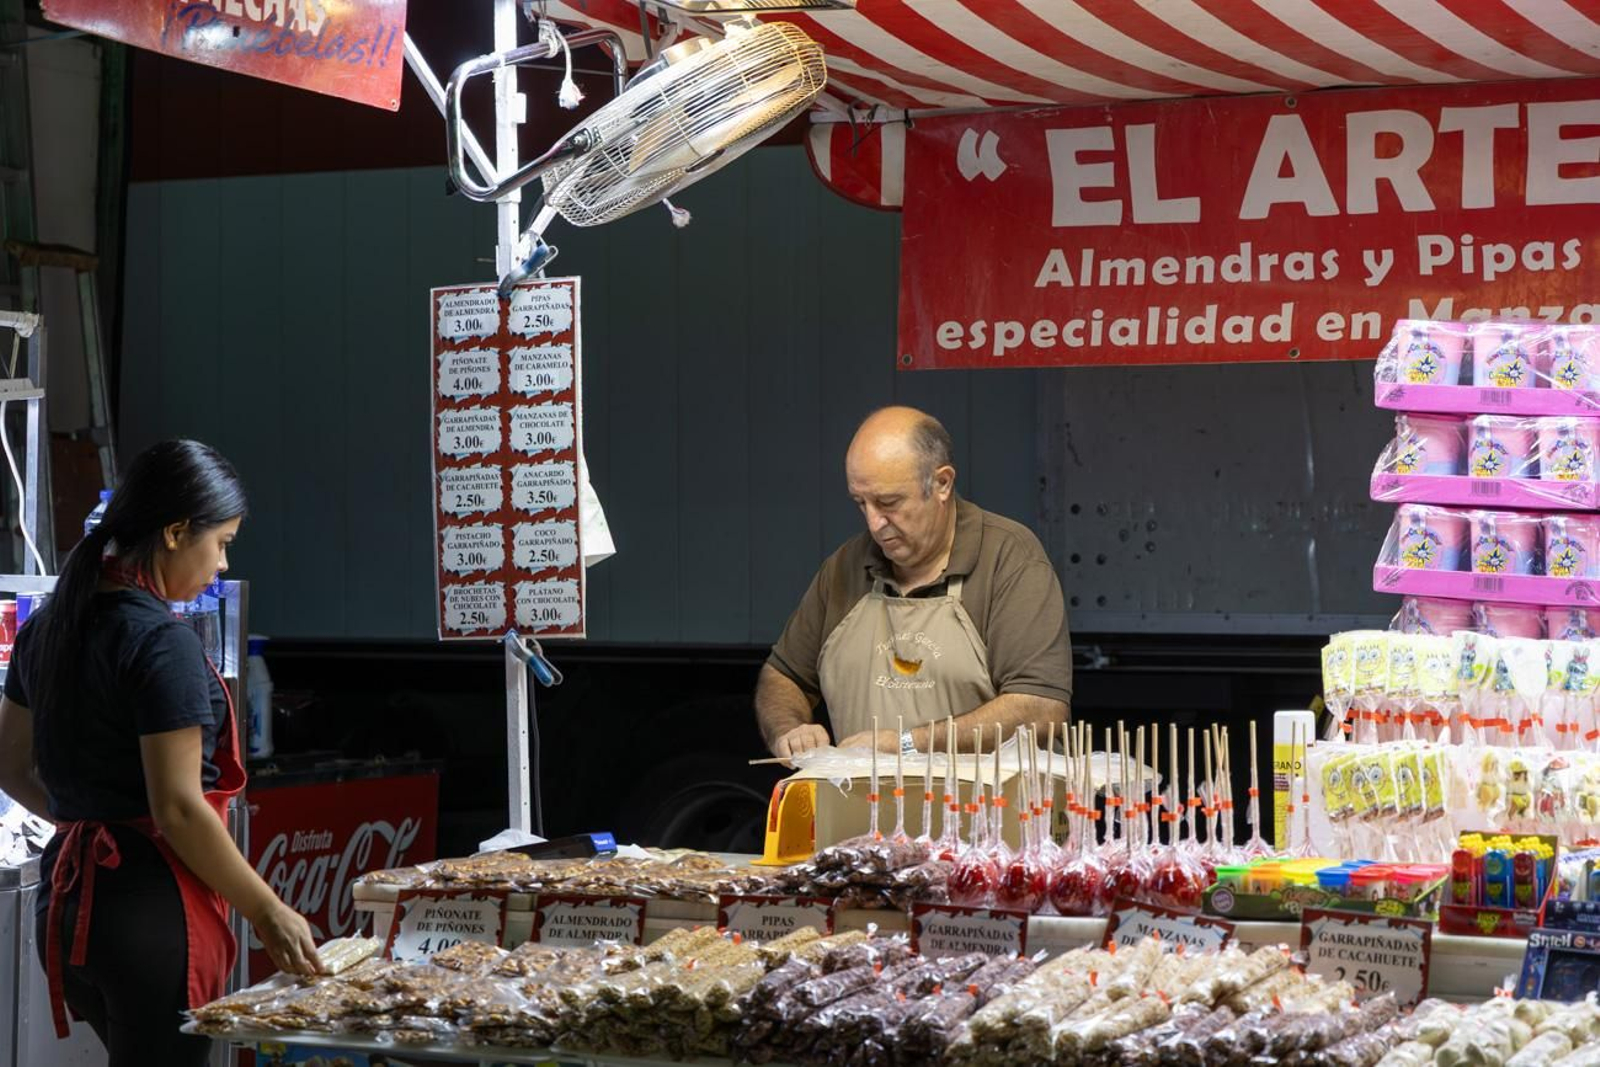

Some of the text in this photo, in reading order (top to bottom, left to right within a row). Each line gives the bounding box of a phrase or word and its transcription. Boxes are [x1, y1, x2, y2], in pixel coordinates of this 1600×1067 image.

[1045, 123, 1200, 227] EL
[1239, 100, 1600, 219] ARTE
[1035, 233, 1582, 289] Almendras y Pipas
[446, 299, 495, 307] ALMENDRADO
[513, 303, 569, 312] GARRAPIÑADAS
[456, 308, 495, 316] ALMENDRA
[454, 319, 482, 332] 3.00€
[524, 315, 554, 328] 2.50€
[936, 302, 1294, 356] especialidad
[1316, 309, 1382, 341] en
[452, 356, 486, 365] PIÑONATE
[521, 353, 561, 361] MANZANAS
[453, 378, 482, 390] 4.00€
[525, 374, 554, 386] 3.00€
[444, 415, 496, 423] GARRAPIÑADAS
[454, 436, 483, 449] 3.00€
[525, 432, 555, 445] 3.00€
[446, 473, 498, 482] GARRAPIÑADAS
[523, 470, 564, 478] ANACARDO
[517, 479, 571, 487] GARRAPIÑADO
[456, 494, 484, 507] 2.50€
[527, 491, 557, 504] 3.50€
[447, 540, 500, 549] GARRAPIÑADO
[519, 537, 572, 546] GARRAPIÑADO
[457, 553, 486, 566] 3.00€
[529, 550, 560, 562] 2.50€
[460, 612, 489, 624] 2.50€
[531, 609, 562, 621] 3.00€
[292, 829, 333, 852] Disfruta
[425, 907, 482, 920] PIÑONATE
[551, 915, 632, 928] ALMENDRADO
[762, 915, 794, 927] PIPAS
[417, 922, 485, 934] DE PIÑONES
[928, 924, 1014, 941] GARRAPIÑADAS
[549, 928, 630, 942] DE ALMENDRA
[930, 939, 945, 950] DE
[1319, 931, 1418, 953] GARRAPIÑADAS
[1319, 947, 1417, 968] DE CACAHUETE
